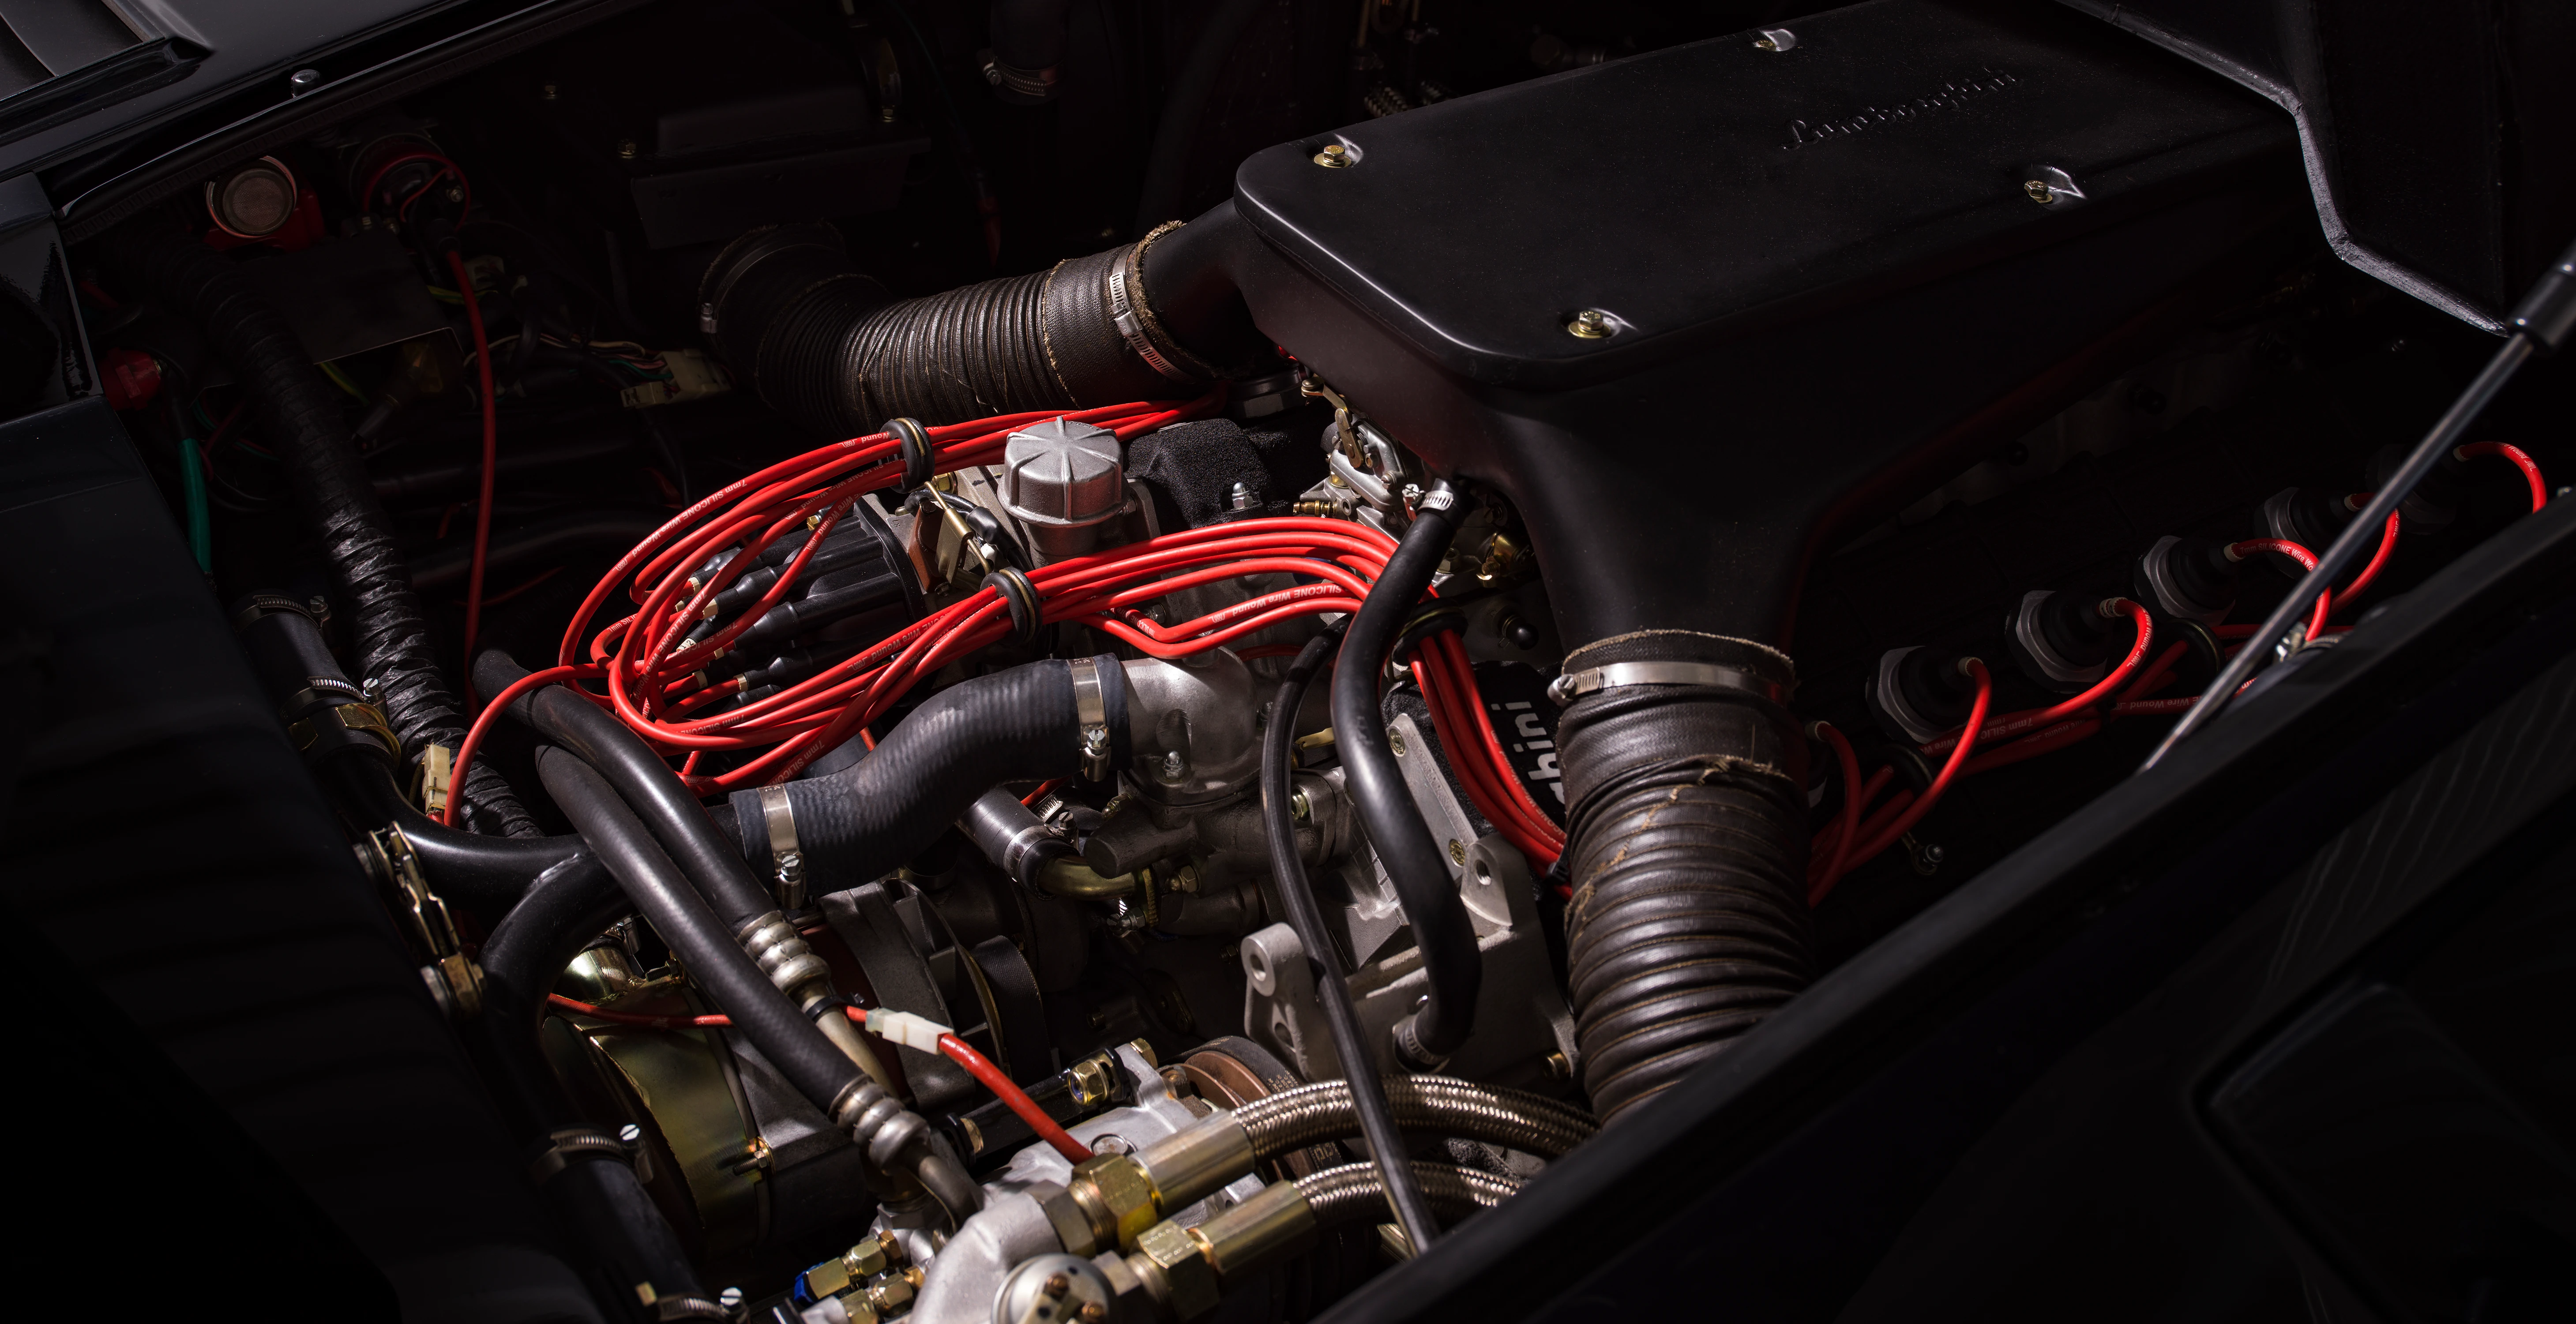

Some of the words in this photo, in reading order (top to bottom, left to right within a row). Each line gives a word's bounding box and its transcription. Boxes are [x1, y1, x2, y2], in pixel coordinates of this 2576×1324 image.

[861, 433, 889, 444] Wound
[847, 464, 883, 482] SILICONE
[725, 479, 747, 493] 7mm
[683, 491, 724, 520] SILICONE
[800, 491, 828, 510] Wound
[837, 495, 854, 511] Wire
[661, 516, 682, 532] Wire
[817, 510, 840, 537] Wound
[632, 532, 661, 558] Wound
[2240, 545, 2257, 555] 7mm
[2258, 543, 2292, 554] SILICONE
[2291, 549, 2305, 562] Wire
[1269, 591, 1291, 603] Wire
[1294, 585, 1342, 599] SILICONE
[688, 591, 707, 611] 7mm
[1232, 600, 1266, 617] Wound
[607, 622, 623, 633] 7mm
[621, 613, 638, 625] SILIC
[717, 621, 738, 637] 7mm
[657, 611, 689, 654] SILICONE
[903, 629, 921, 643] Wire
[2140, 627, 2153, 652] Wound
[871, 641, 901, 662] Wound
[646, 653, 661, 673] Wire
[633, 673, 651, 700] Wound
[2129, 700, 2164, 710] Wound
[2167, 698, 2189, 706] Wire
[722, 714, 745, 726] 7mm
[2009, 718, 2034, 731] 7mm
[1980, 726, 2006, 740] SILIC
[2044, 725, 2069, 740] Wound
[804, 740, 825, 761] 7mm
[1935, 739, 1956, 750] Wire
